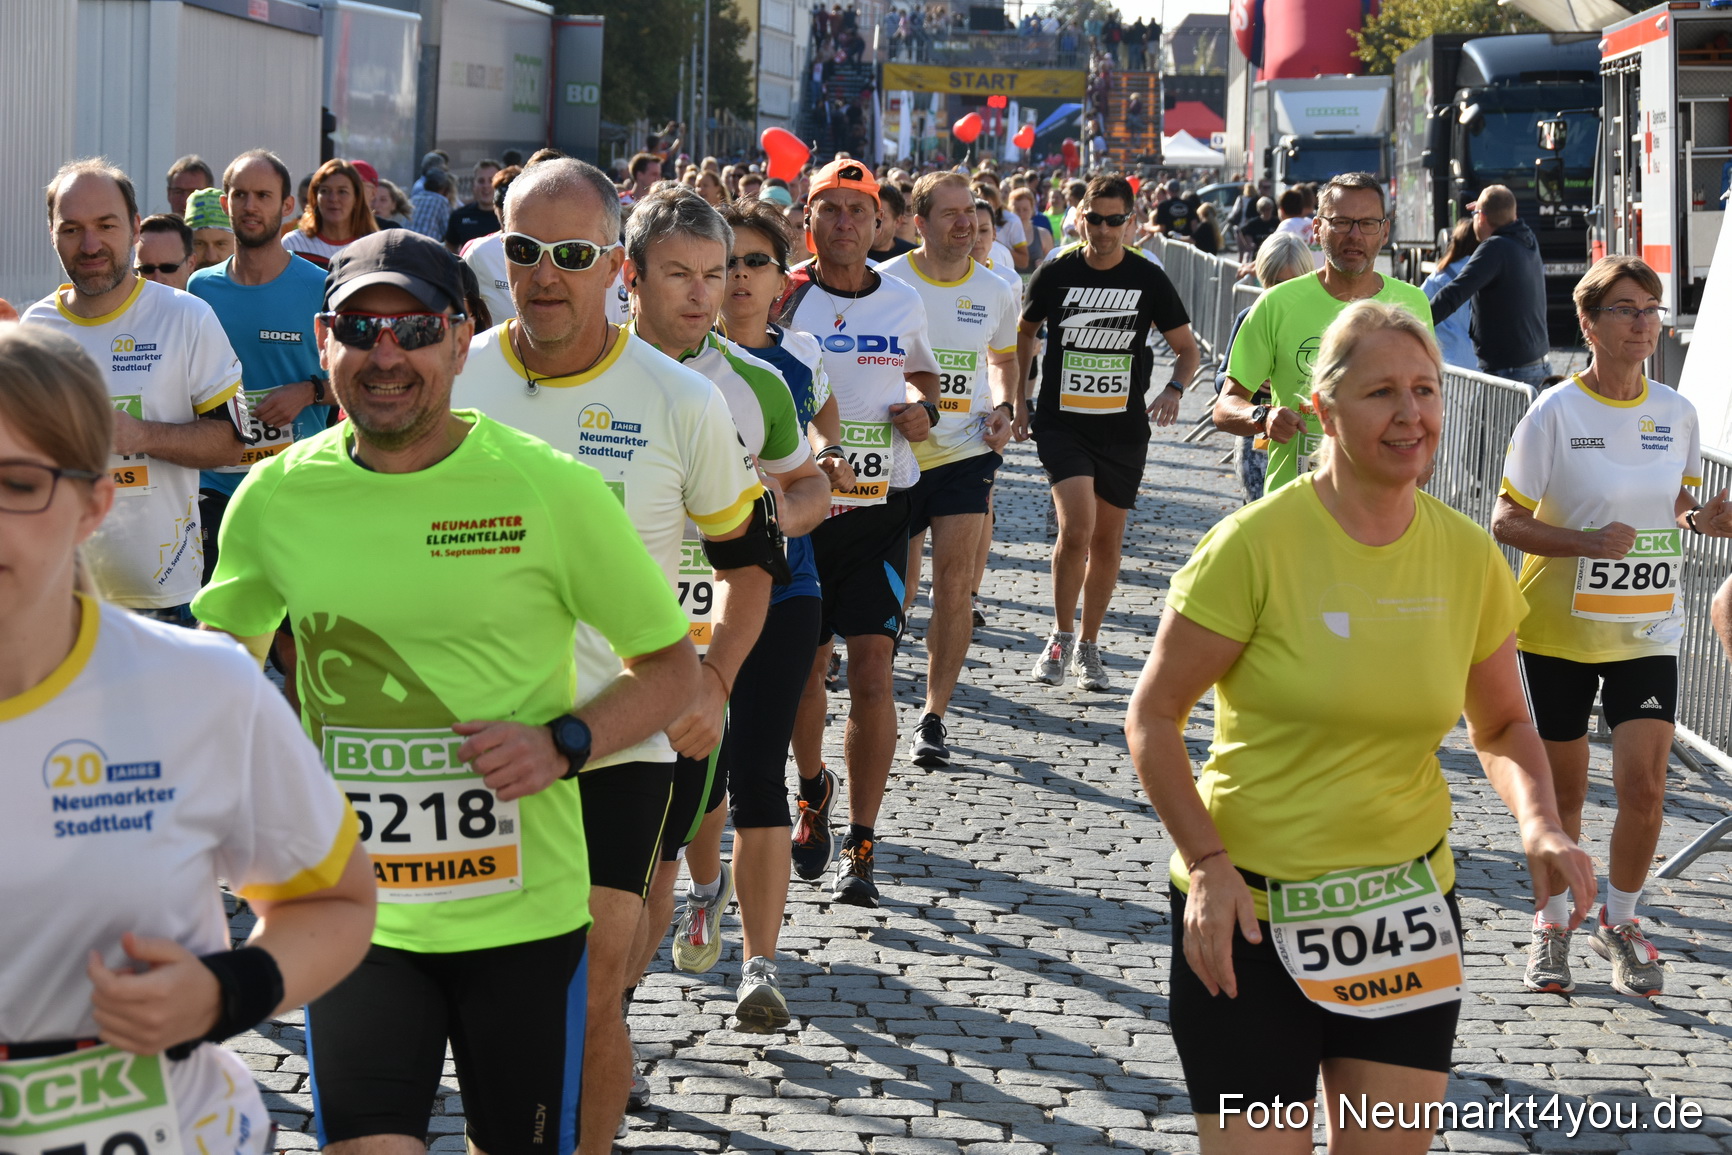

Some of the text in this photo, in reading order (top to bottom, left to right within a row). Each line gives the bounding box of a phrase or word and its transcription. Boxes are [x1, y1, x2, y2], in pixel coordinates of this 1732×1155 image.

[949, 72, 1018, 90] START
[566, 83, 599, 103] BO
[957, 299, 971, 309] 20
[1061, 287, 1142, 309] PUMA
[957, 310, 988, 318] Neumarkter
[957, 317, 982, 325] Stadtlauf
[259, 330, 302, 341] BOCK
[1060, 328, 1137, 350] PUMA
[113, 339, 134, 353] 20
[112, 353, 162, 362] Neumarkter
[1068, 355, 1125, 370] BOCK
[111, 363, 152, 372] Stadtlauf
[940, 373, 967, 394] 38
[1069, 374, 1123, 394] 5265
[581, 410, 639, 432] 20 JAHRE
[1640, 420, 1655, 432] 20
[580, 432, 649, 447] Neumarkter
[1570, 437, 1605, 446] BOCK
[1641, 443, 1669, 451] Stadtlauf
[578, 445, 634, 461] Stadtlauf
[848, 452, 882, 477] 48
[431, 515, 523, 531] NEUMARKTER
[426, 529, 526, 545] ELEMENTELAUF
[445, 547, 497, 558] September
[499, 546, 521, 554] 2019
[1589, 562, 1670, 590] 5280
[678, 582, 713, 615] 79
[51, 752, 157, 788] 20 JAHRE
[52, 787, 176, 812] Neumarkter
[54, 810, 153, 838] Stadtlauf
[345, 789, 496, 842] 5218
[1283, 866, 1424, 917] BOCK
[1297, 906, 1437, 971] 5045
[1333, 972, 1423, 1001] SONJA
[533, 1103, 547, 1144] ACTIVE
